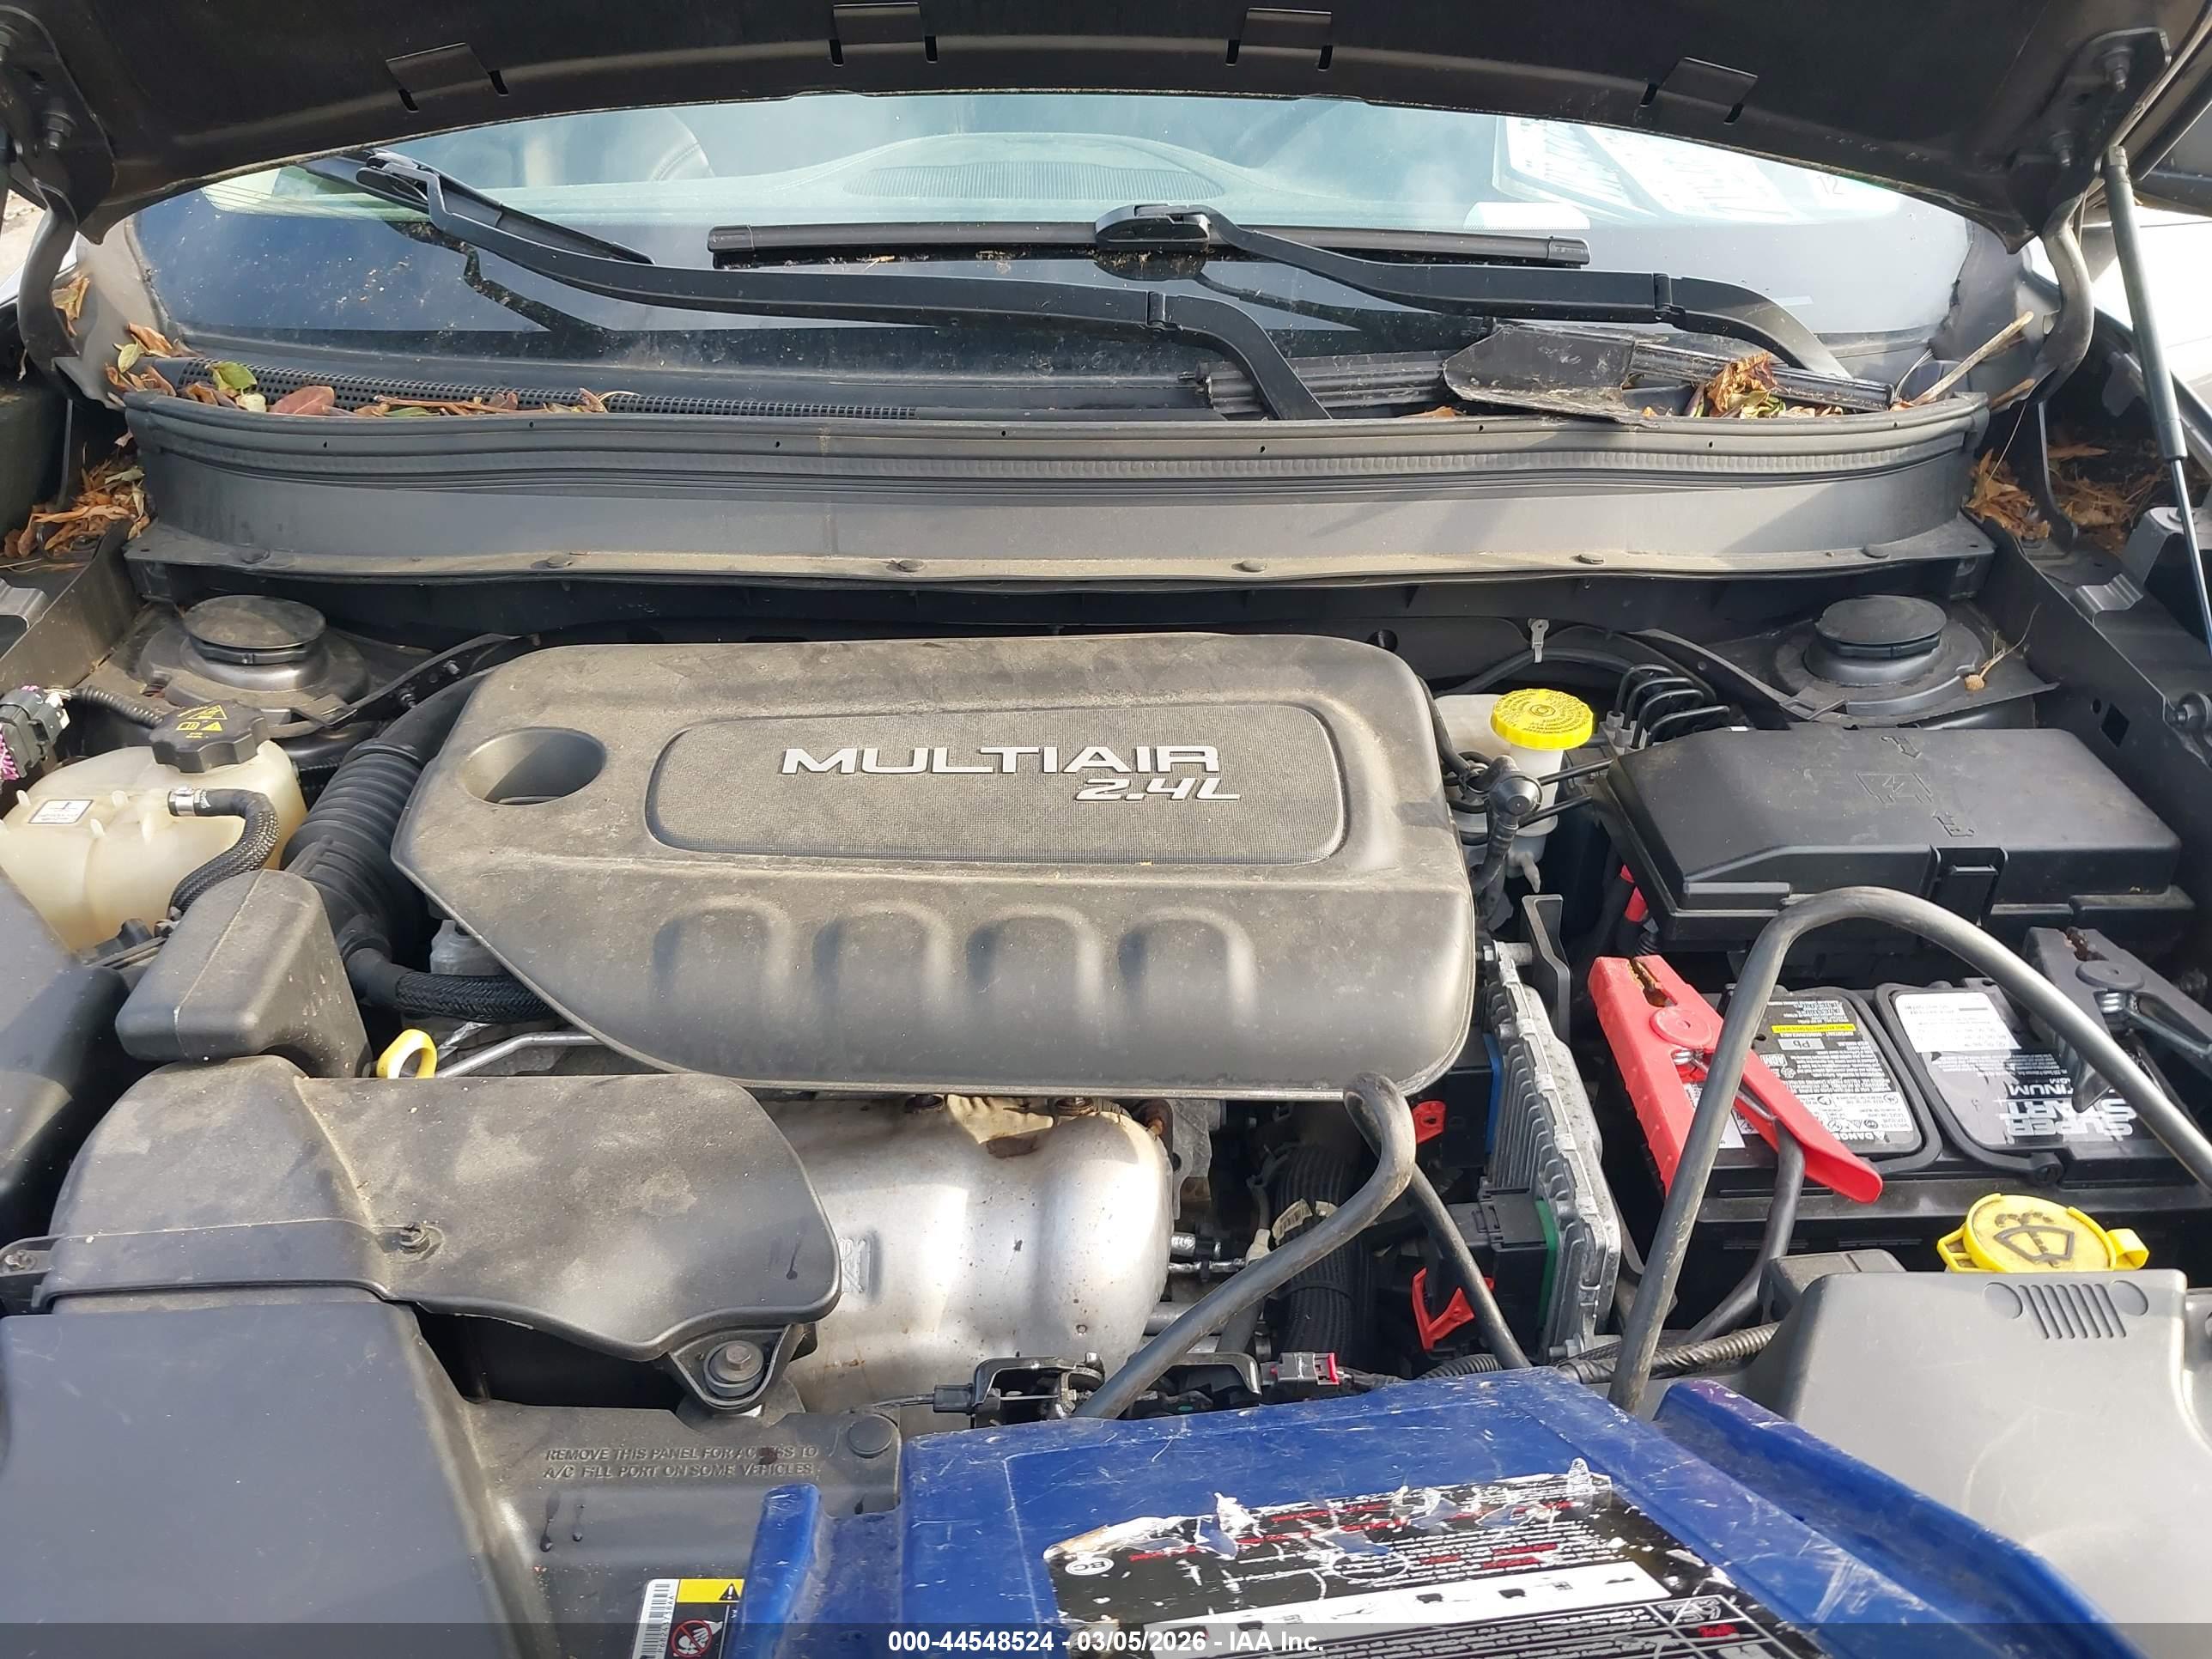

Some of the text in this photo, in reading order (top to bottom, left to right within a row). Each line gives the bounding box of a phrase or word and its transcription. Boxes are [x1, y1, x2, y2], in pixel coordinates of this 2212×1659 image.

[781, 746, 1221, 774] MULTIAIR
[1073, 777, 1242, 801] 2.4L
[2006, 1118, 2134, 1136] SUPER
[546, 1445, 818, 1462] REMOVE THIS PANEL FOR ACSS TO
[543, 1462, 814, 1479] A/C FILL PORT ON SOME VEHICLES
[1073, 1561, 1107, 1572] BC
